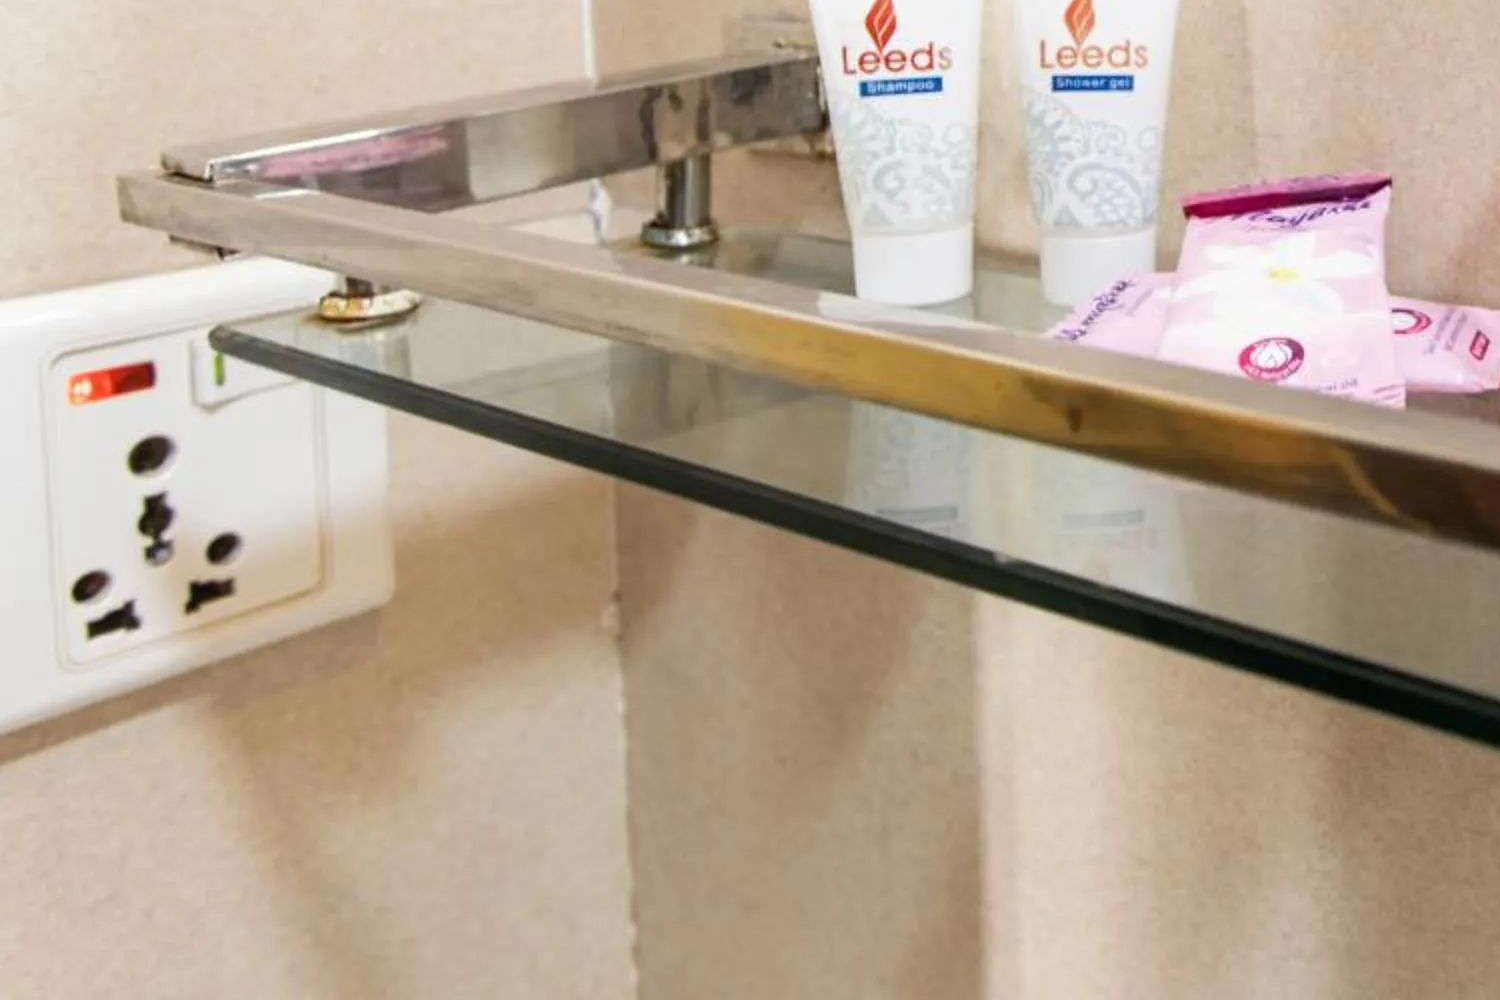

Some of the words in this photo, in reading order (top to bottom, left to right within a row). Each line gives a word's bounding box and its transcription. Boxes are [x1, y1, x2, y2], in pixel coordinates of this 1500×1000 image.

[842, 41, 952, 74] Leeds
[1039, 39, 1149, 69] Leeds
[866, 79, 935, 93] Shampoo
[1056, 77, 1105, 90] Shower
